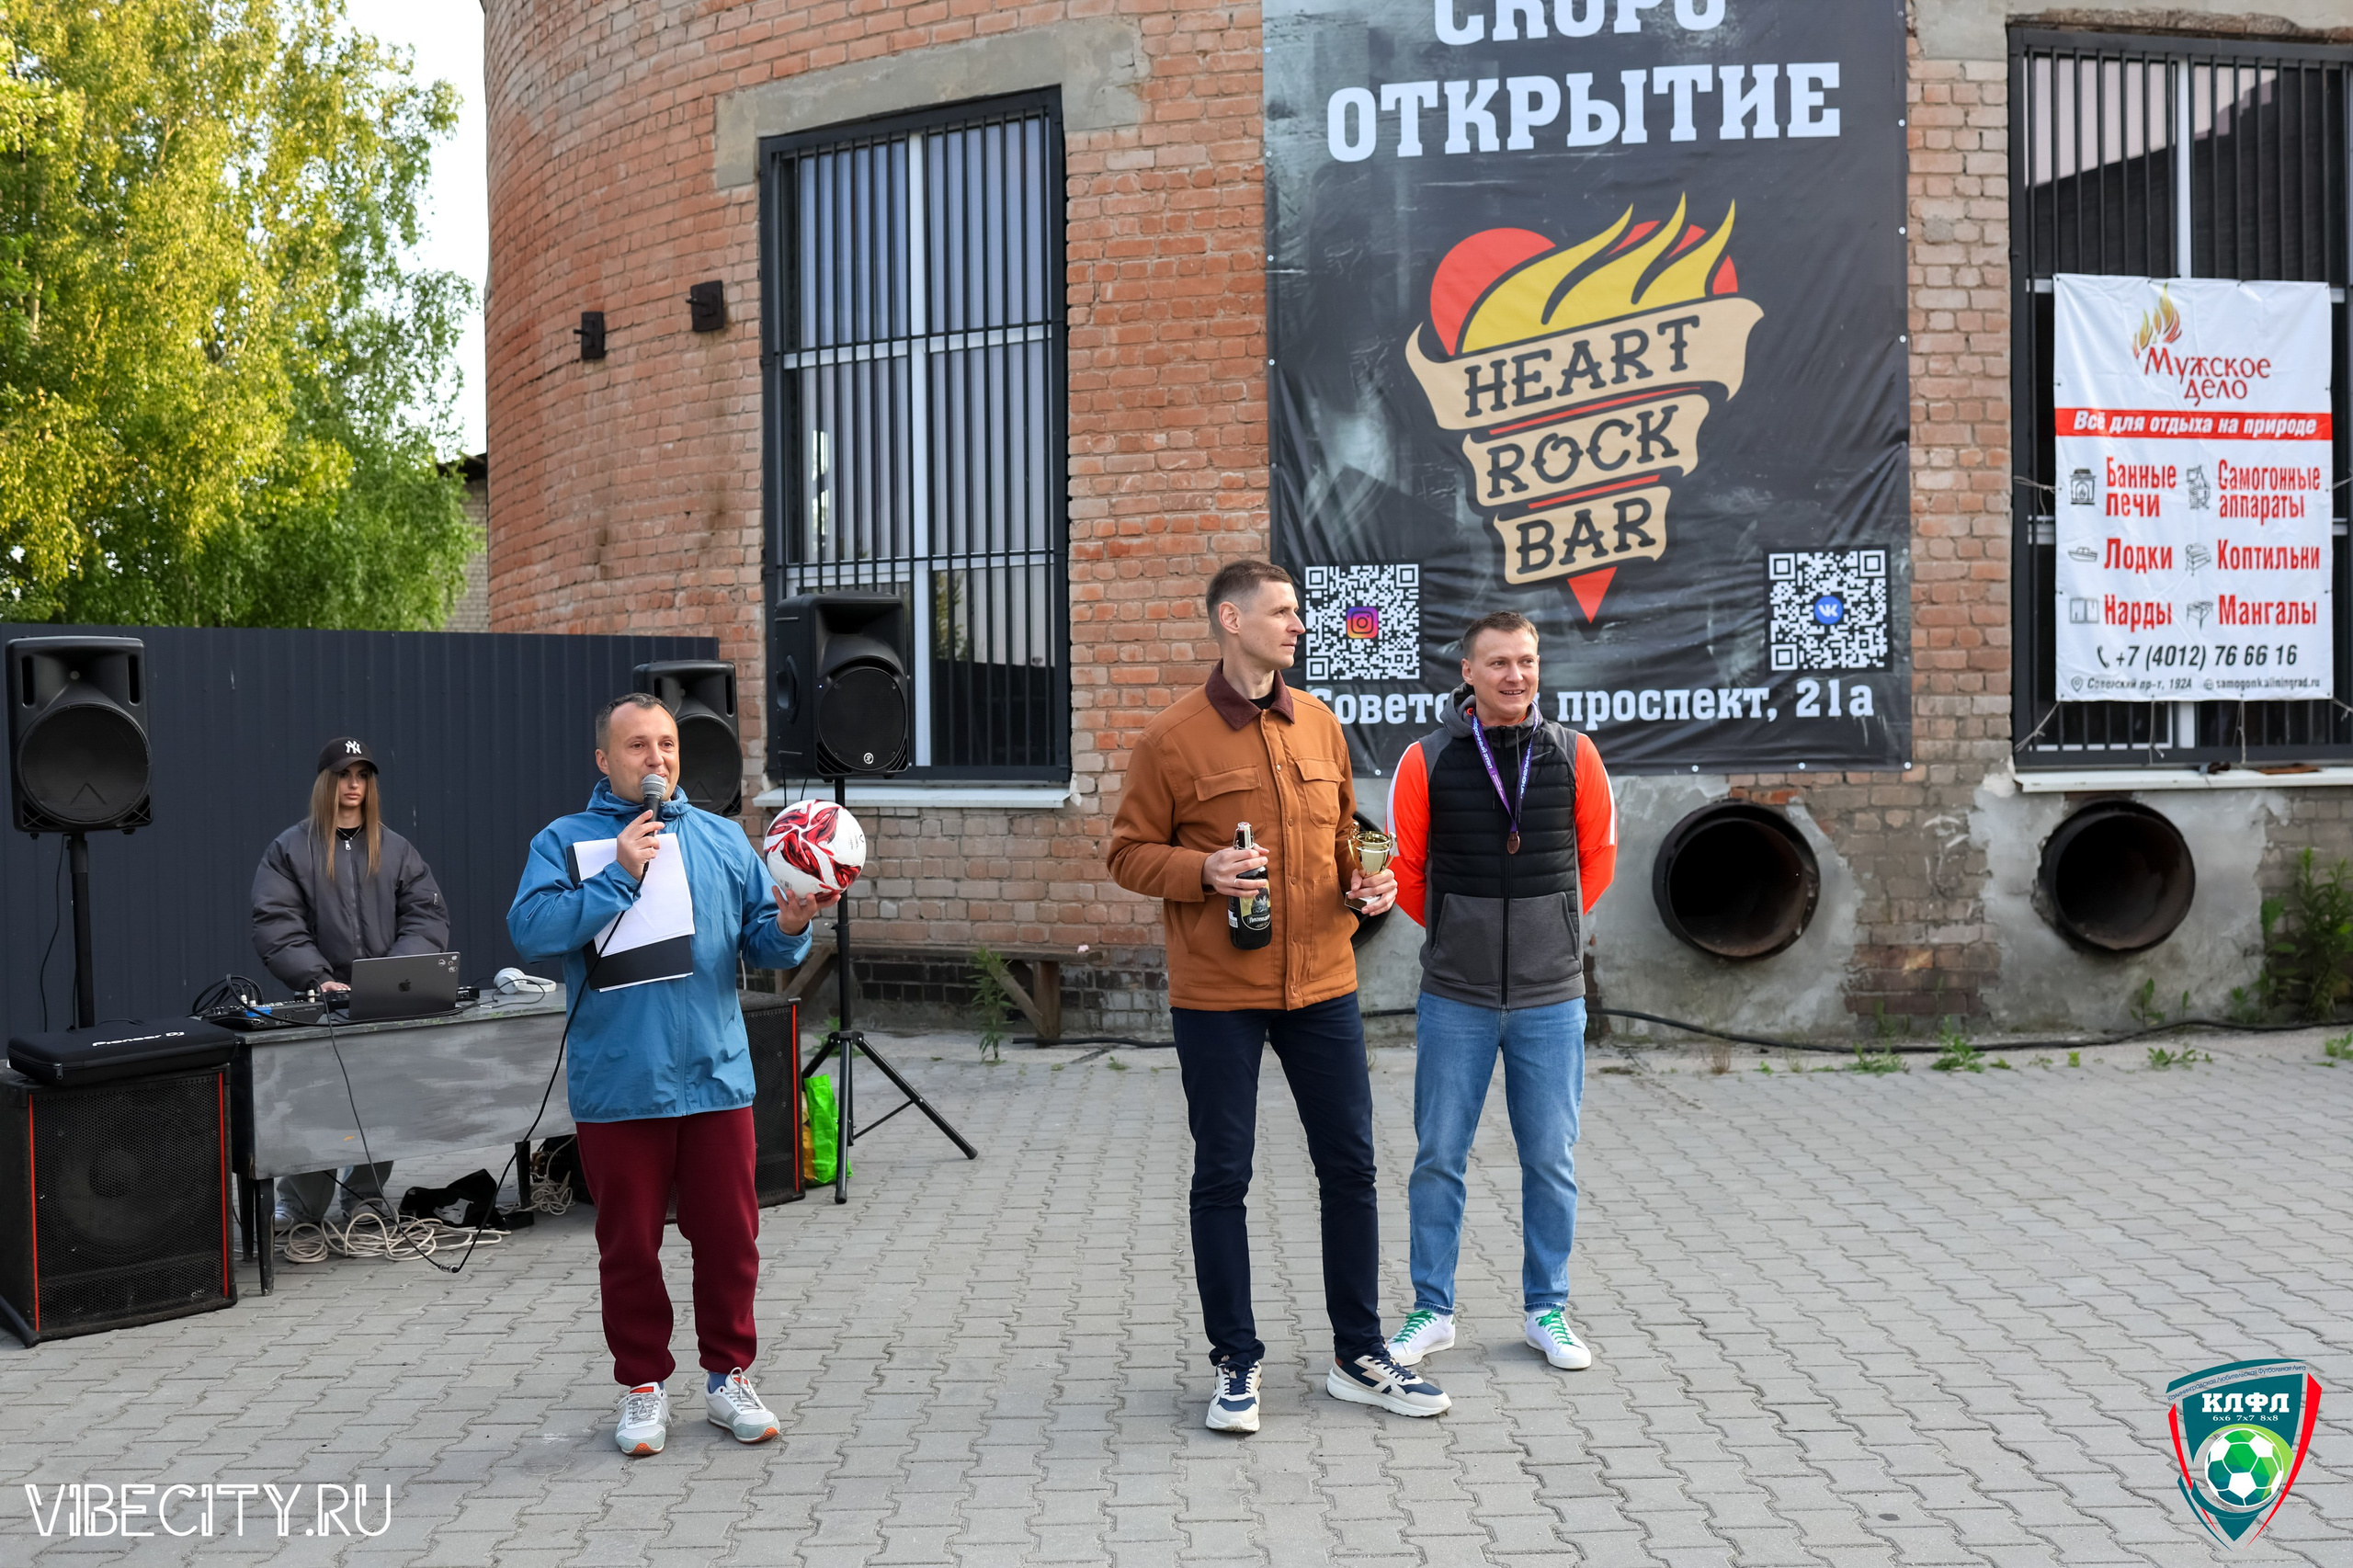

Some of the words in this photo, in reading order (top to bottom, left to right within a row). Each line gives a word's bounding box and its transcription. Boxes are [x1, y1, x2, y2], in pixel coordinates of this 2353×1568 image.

[1326, 62, 1841, 163] ОТКРЫТИЕ
[1464, 314, 1700, 418] HEART
[2143, 347, 2272, 384] Мужское
[2109, 415, 2145, 436] для
[2149, 415, 2213, 436] отдыха
[2217, 417, 2239, 435] на
[2243, 418, 2318, 438] природе
[1486, 404, 1680, 499] ROCK
[2106, 456, 2177, 490] Банные
[2217, 459, 2321, 492] Самогонные
[2105, 493, 2161, 518] печи
[2219, 493, 2305, 527] аппараты
[1516, 496, 1657, 575] BAR
[2104, 538, 2173, 574] Лодки
[2217, 539, 2321, 571] Коптильни
[2104, 594, 2172, 633] Нарды
[2218, 595, 2317, 626] Мангалы
[2116, 645, 2141, 667] +7
[2145, 644, 2207, 672] (4012)
[2213, 645, 2238, 667] 76
[2244, 645, 2269, 667] 66
[2275, 644, 2299, 666] 16
[1556, 687, 1779, 732] проспект,
[1795, 678, 1874, 718] 21а
